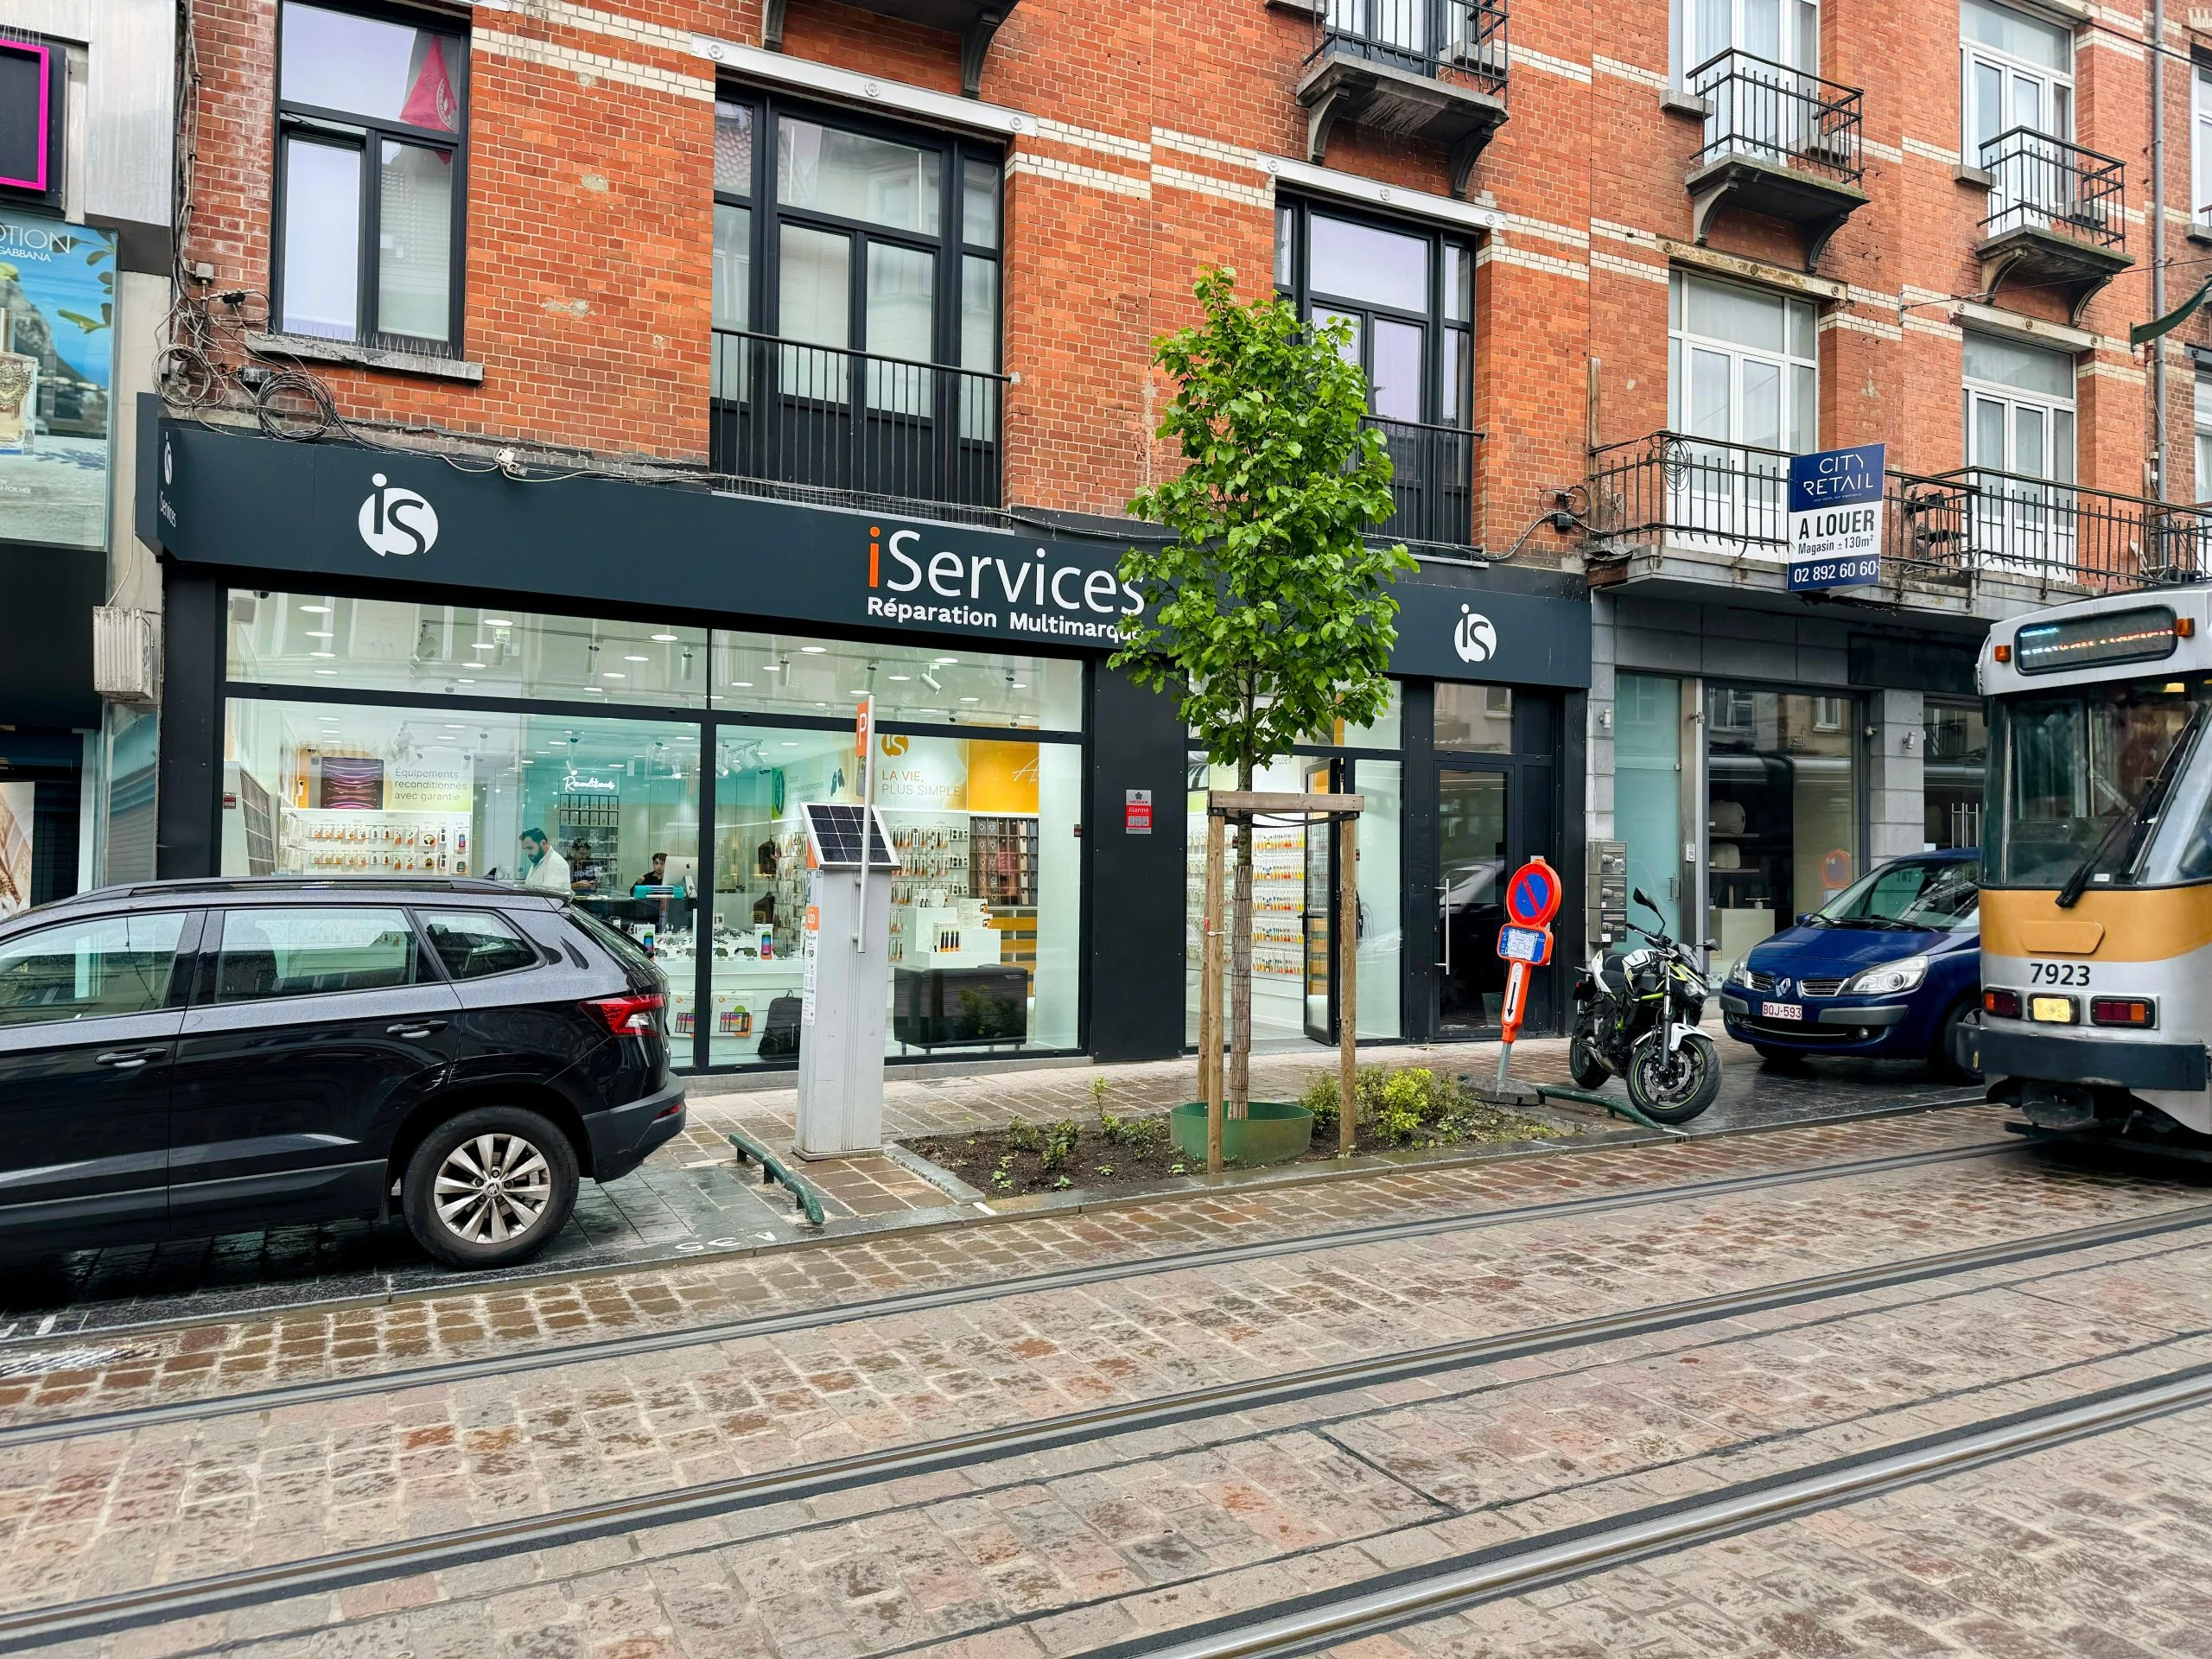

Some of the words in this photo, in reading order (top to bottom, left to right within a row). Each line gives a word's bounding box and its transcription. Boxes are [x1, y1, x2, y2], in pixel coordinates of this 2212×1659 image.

[0, 225, 70, 254] TION
[1820, 454, 1864, 474] CITY
[1803, 473, 1873, 496] RETAIL
[1798, 518, 1809, 540] A
[1816, 509, 1875, 537] LOUER
[1798, 540, 1834, 556] Magasin
[868, 526, 1145, 616] iServices
[1794, 568, 1809, 583] 02
[1812, 564, 1836, 582] 892
[1839, 563, 1856, 578] 60
[1859, 560, 1876, 576] 60
[867, 596, 997, 629] Réparation
[859, 712, 868, 747] P
[395, 766, 460, 779] Équipements
[882, 769, 898, 780] LA
[901, 771, 924, 784] VIE,
[394, 780, 467, 791] reconditionnés
[881, 784, 913, 795] PLUS
[917, 785, 961, 797] SIMPLE
[421, 793, 461, 802] garantie
[2030, 963, 2091, 987] 7923
[1764, 1004, 1802, 1019] BQJ-593
